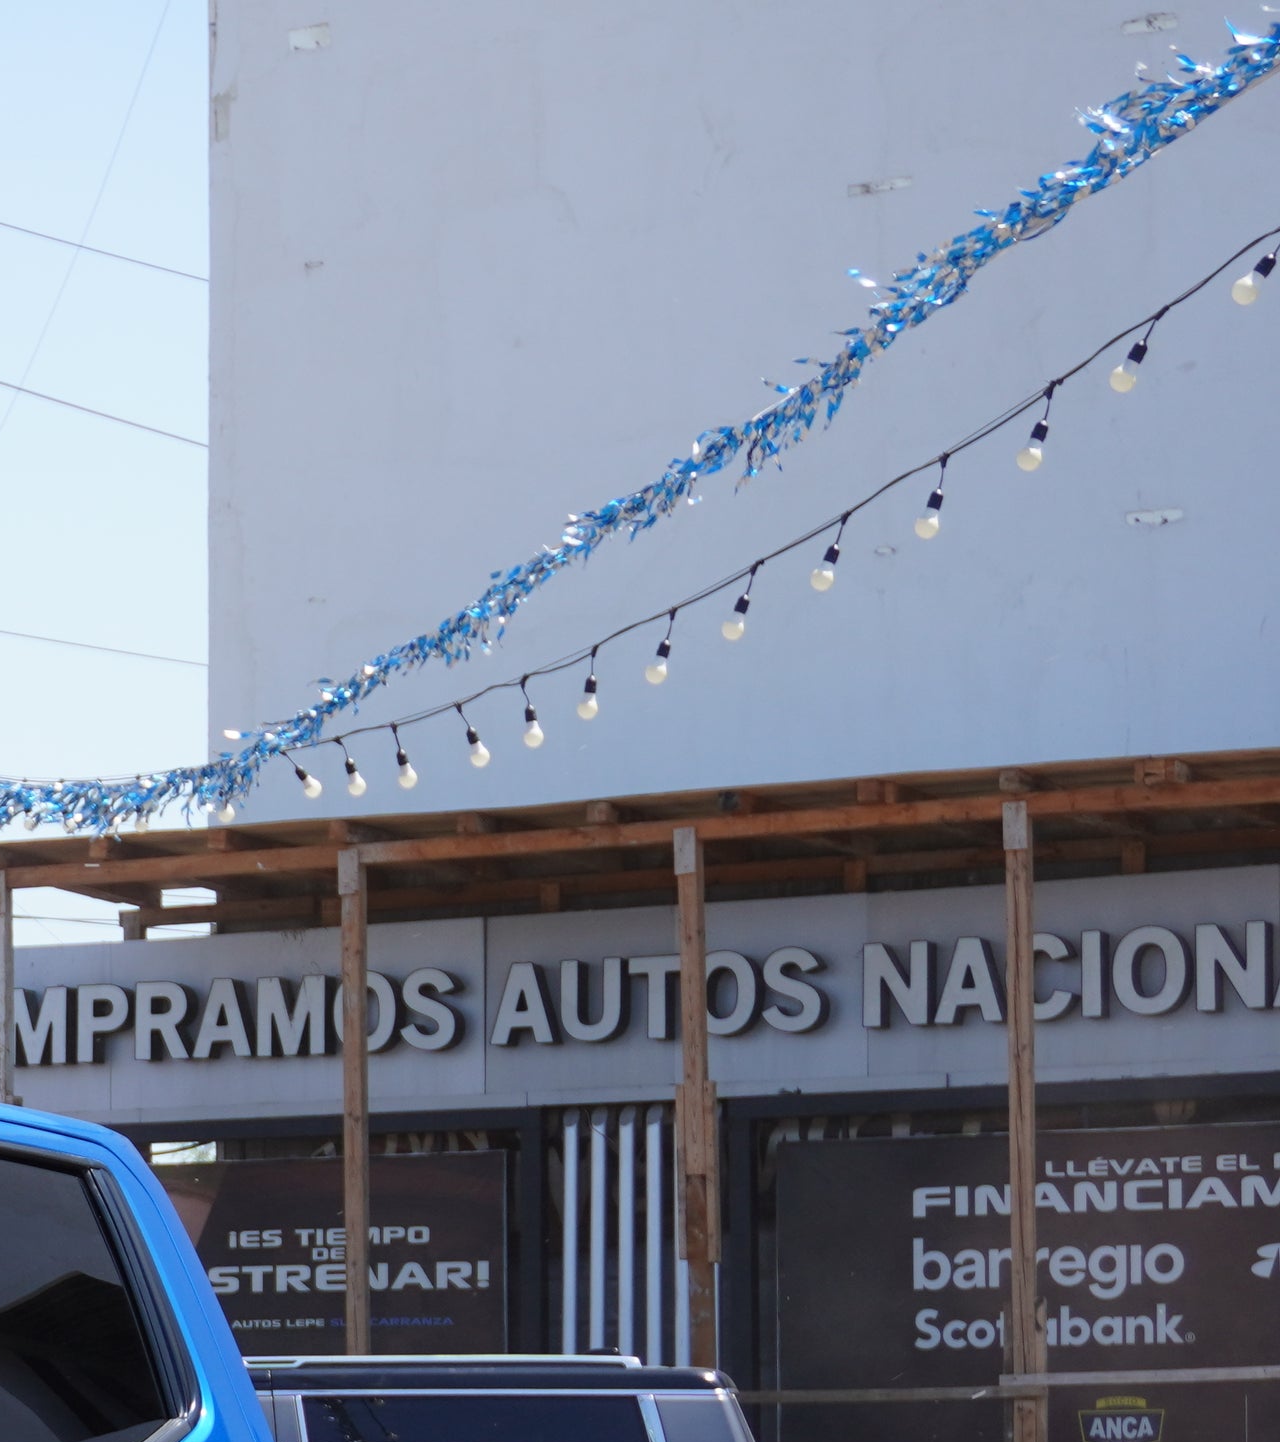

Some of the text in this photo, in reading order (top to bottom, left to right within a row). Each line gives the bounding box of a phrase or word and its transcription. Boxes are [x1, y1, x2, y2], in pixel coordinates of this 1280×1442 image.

[490, 946, 828, 1047] AUTOS
[861, 920, 1280, 1029] NACION
[1045, 1155, 1203, 1178] LLÉVATE
[1217, 1153, 1260, 1172] EL
[912, 1174, 1280, 1219] FINANCIAM
[312, 1247, 346, 1262] DE
[207, 1260, 490, 1294] STRENAR!
[232, 1318, 282, 1329] AUTOS
[286, 1317, 325, 1328] LEPE
[914, 1303, 1184, 1350] Scobank
[1089, 1415, 1154, 1441] ANCA
